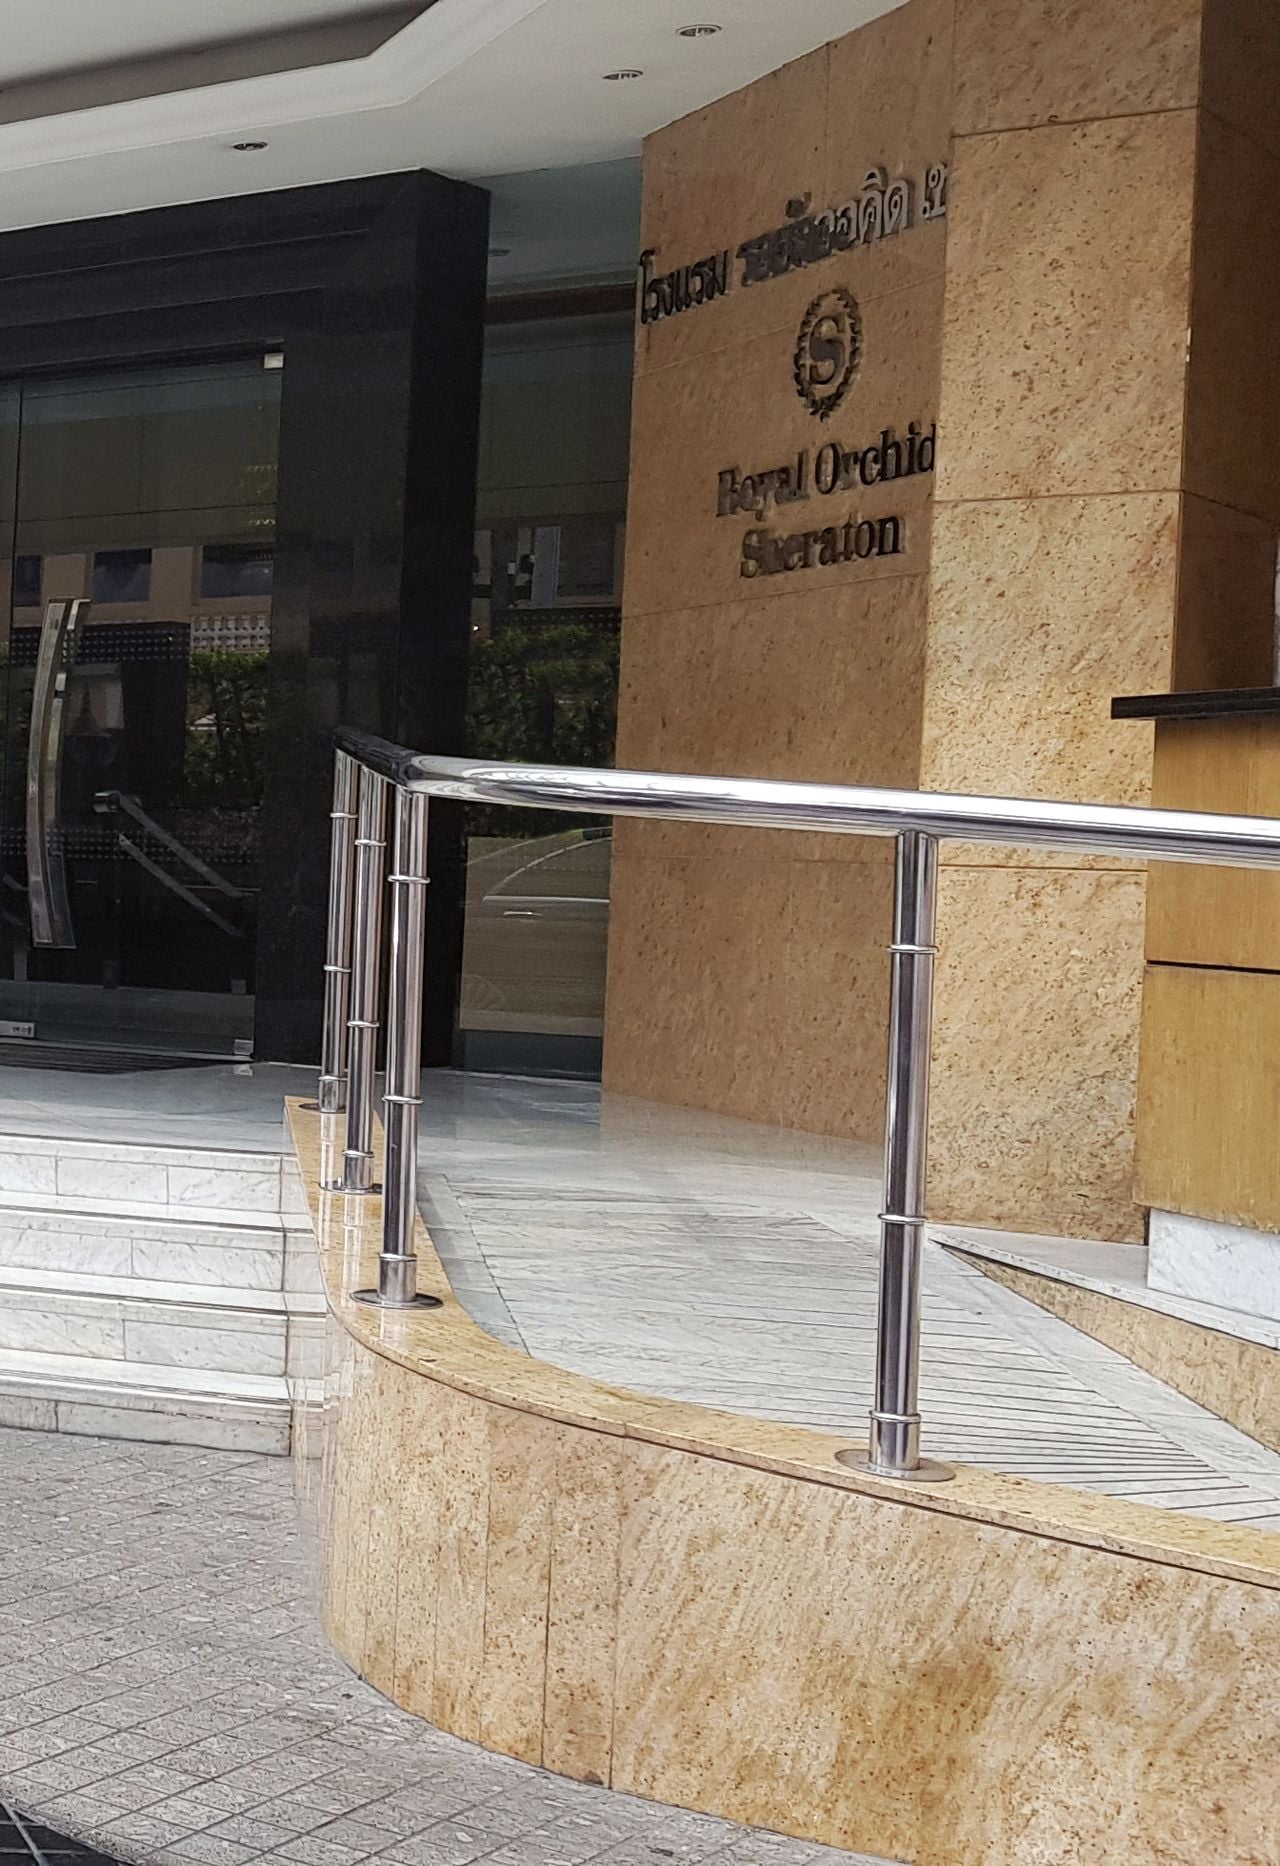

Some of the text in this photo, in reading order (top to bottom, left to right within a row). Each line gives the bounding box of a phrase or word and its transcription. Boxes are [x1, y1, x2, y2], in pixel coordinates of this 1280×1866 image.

[716, 421, 937, 521] Royal Orchid
[740, 513, 905, 578] Sheraton
